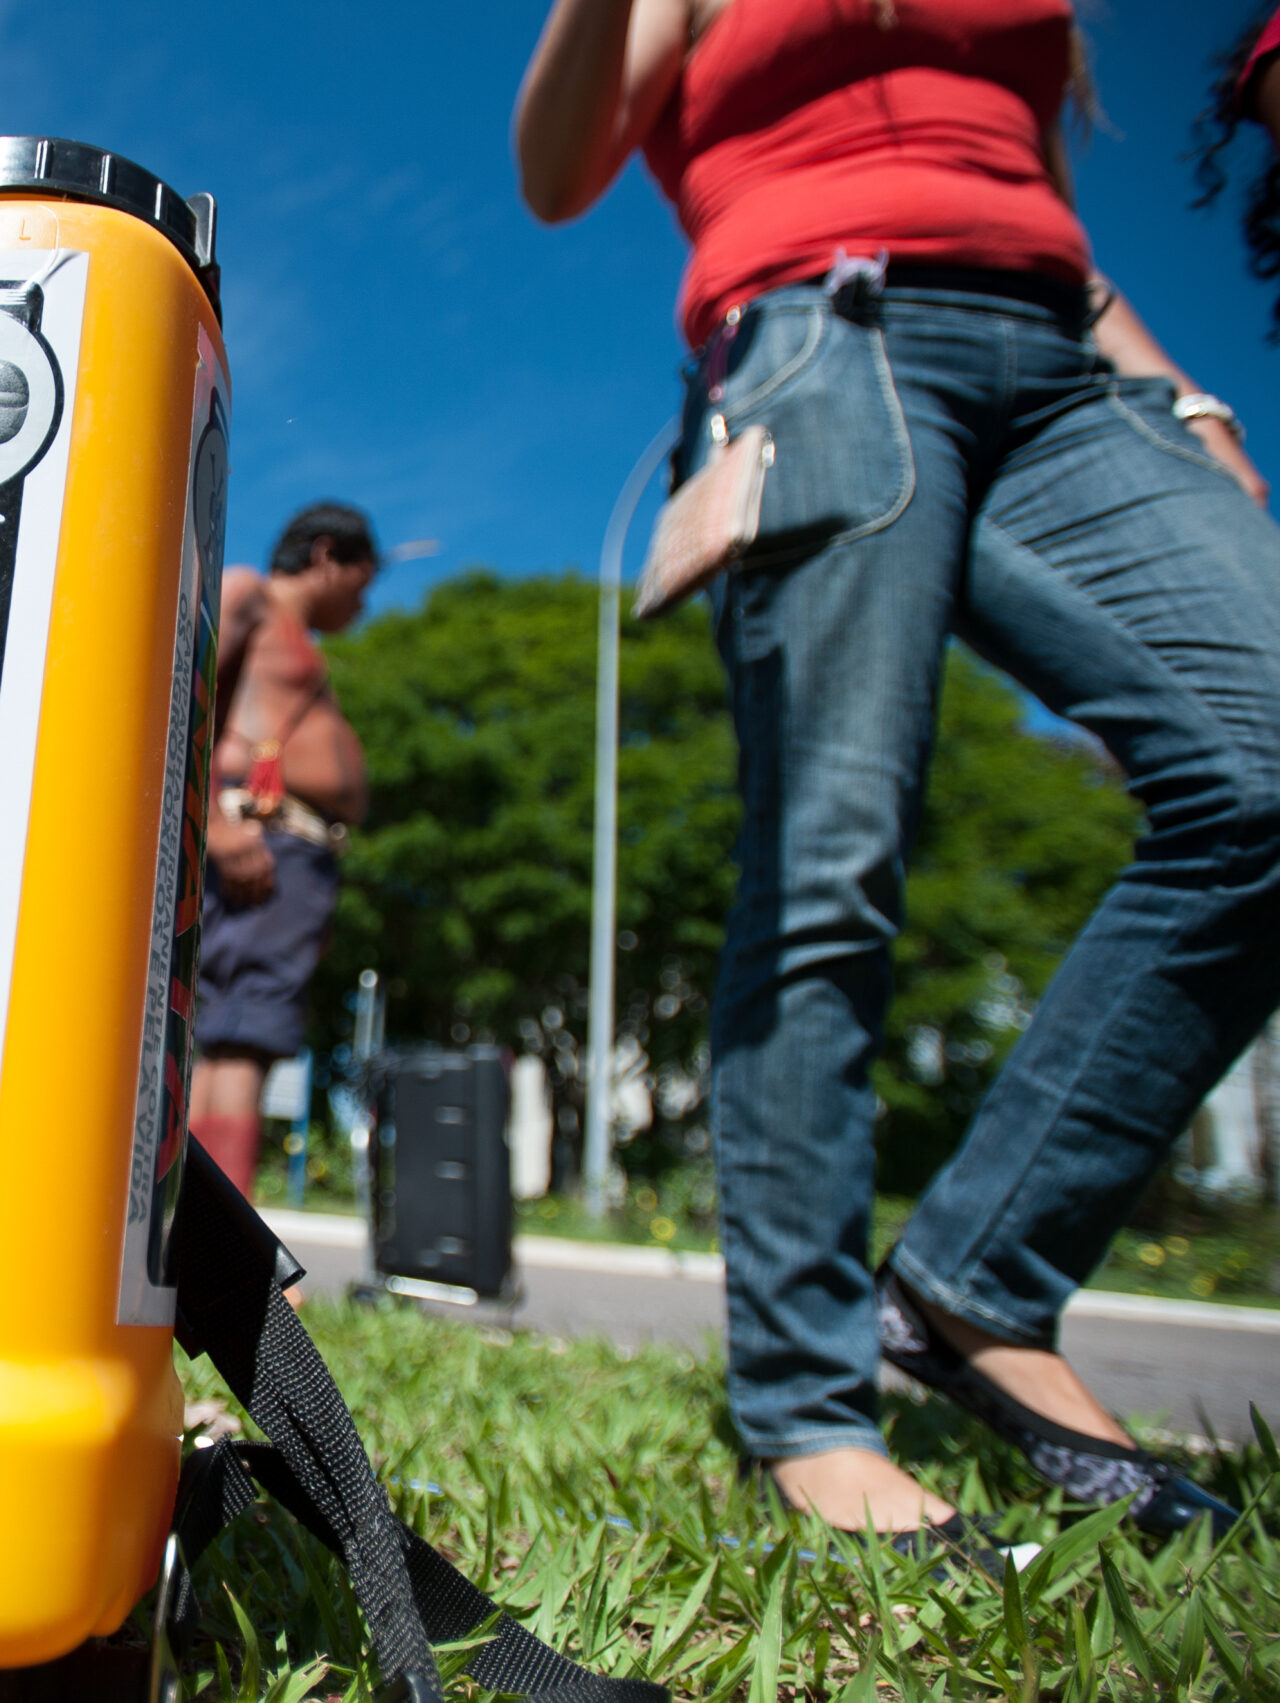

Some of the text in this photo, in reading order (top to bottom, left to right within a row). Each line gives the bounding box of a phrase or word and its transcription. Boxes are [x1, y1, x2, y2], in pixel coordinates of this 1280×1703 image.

[178, 592, 188, 638] OS
[138, 619, 193, 1224] CAMPANHA PERMANENTE CONTRA
[150, 951, 161, 973] E
[156, 666, 211, 1185] MATA
[138, 986, 156, 1096] PELA
[127, 1112, 149, 1227] VIDA
